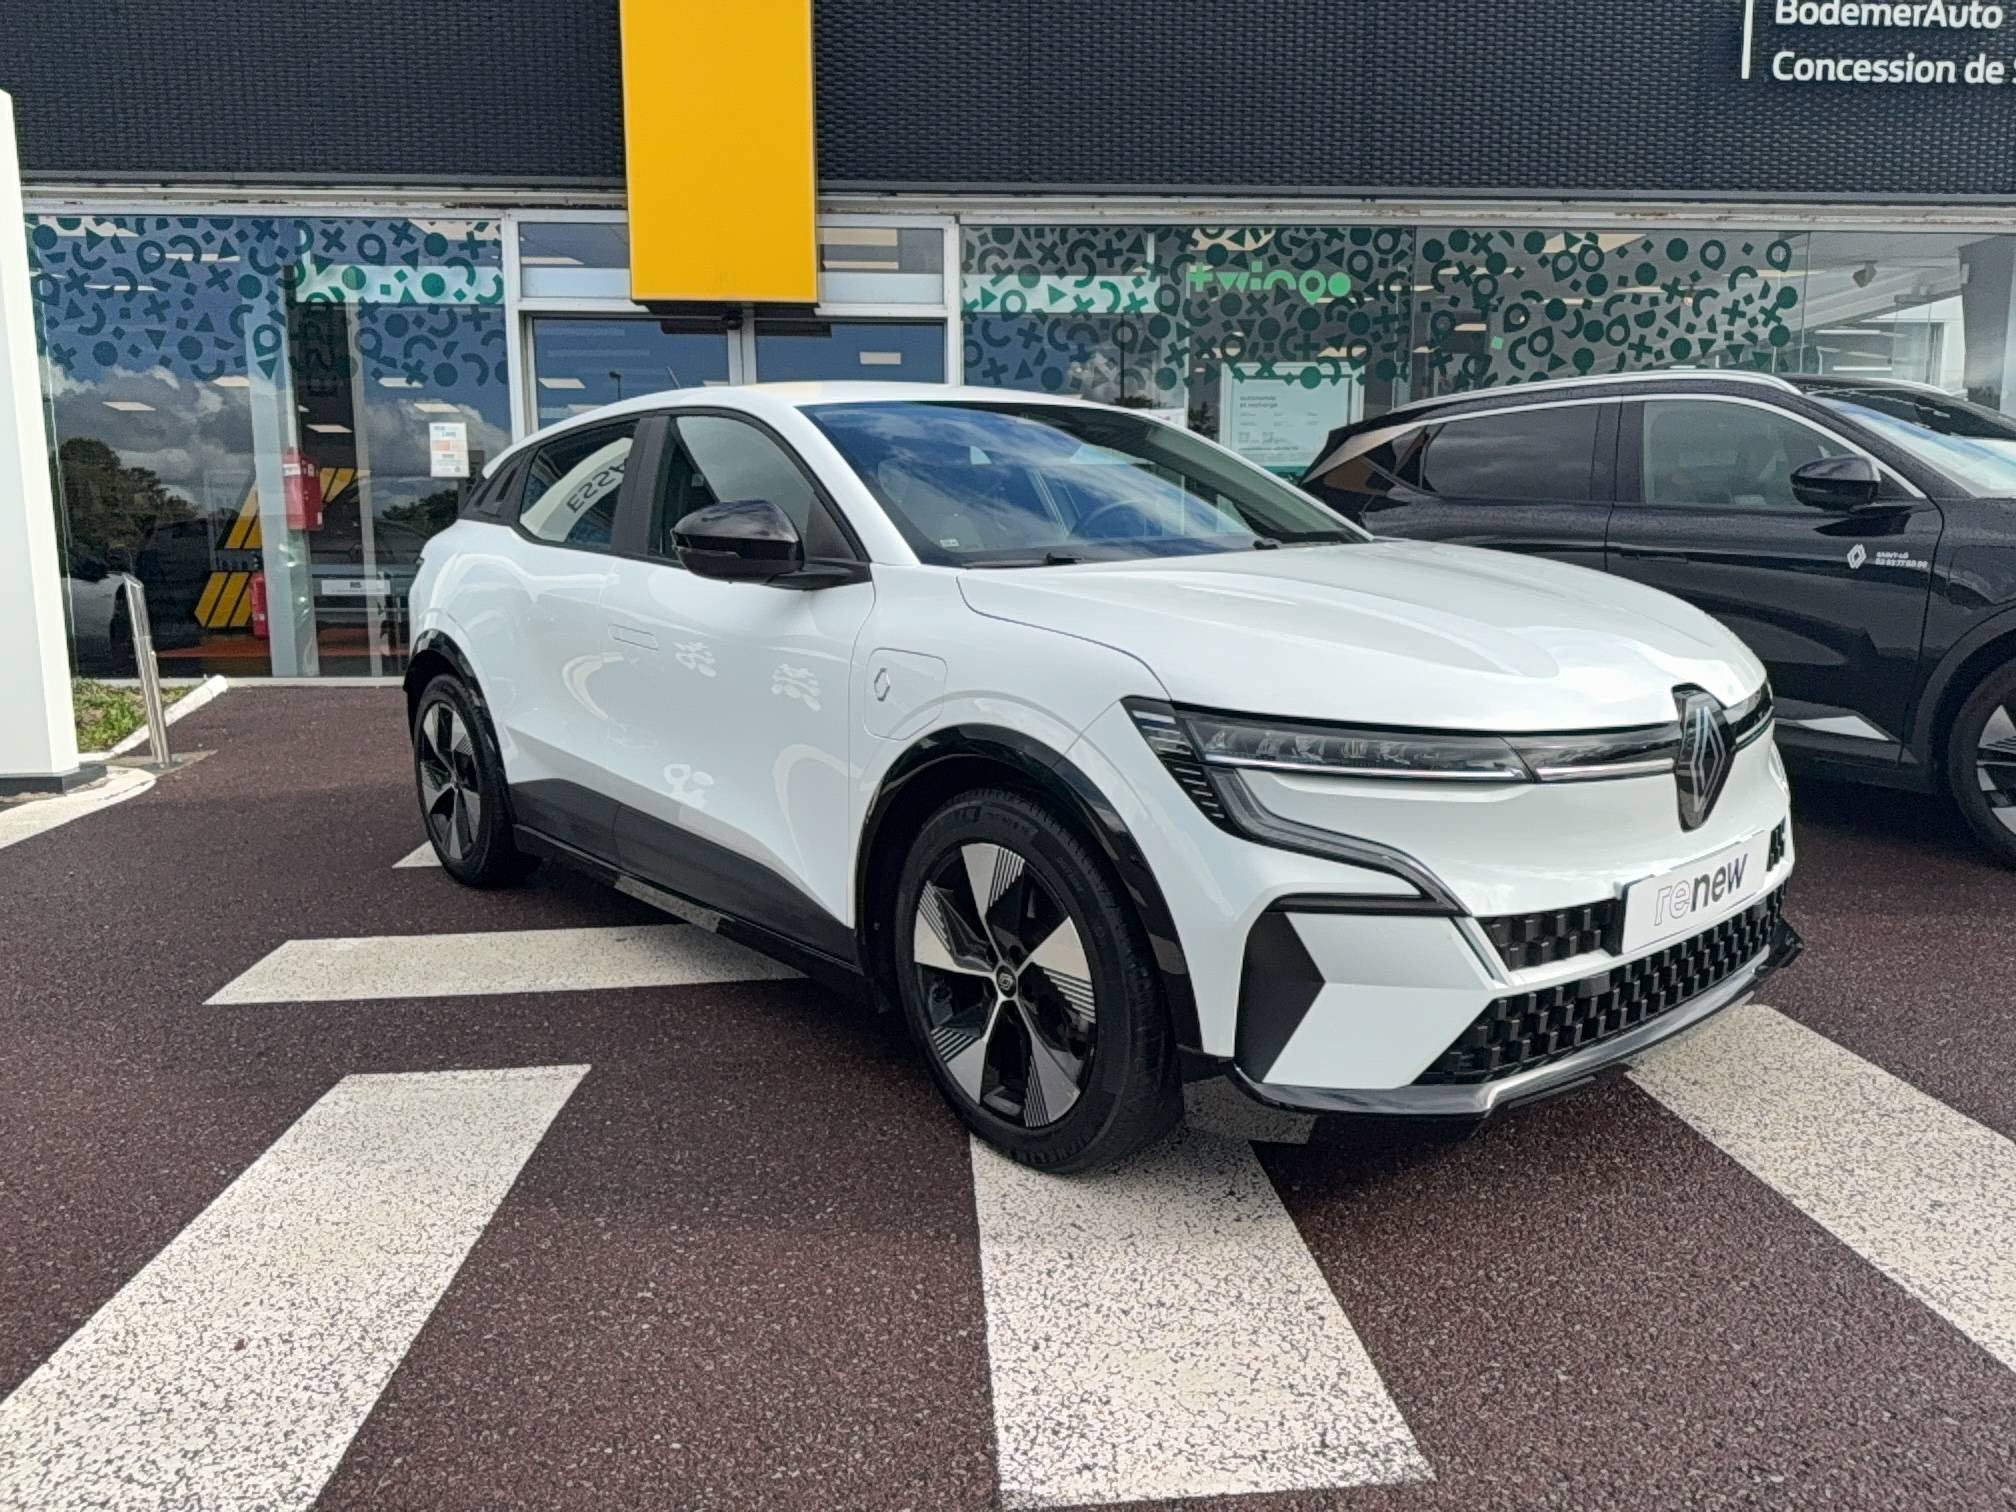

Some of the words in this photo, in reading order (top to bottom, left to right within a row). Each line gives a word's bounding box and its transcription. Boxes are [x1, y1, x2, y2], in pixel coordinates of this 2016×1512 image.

[1775, 0, 2003, 29] BodemerAuto
[1772, 51, 1956, 83] Concession
[1964, 53, 2005, 85] de
[1189, 262, 1351, 305] twingo
[1654, 854, 1748, 927] renew
